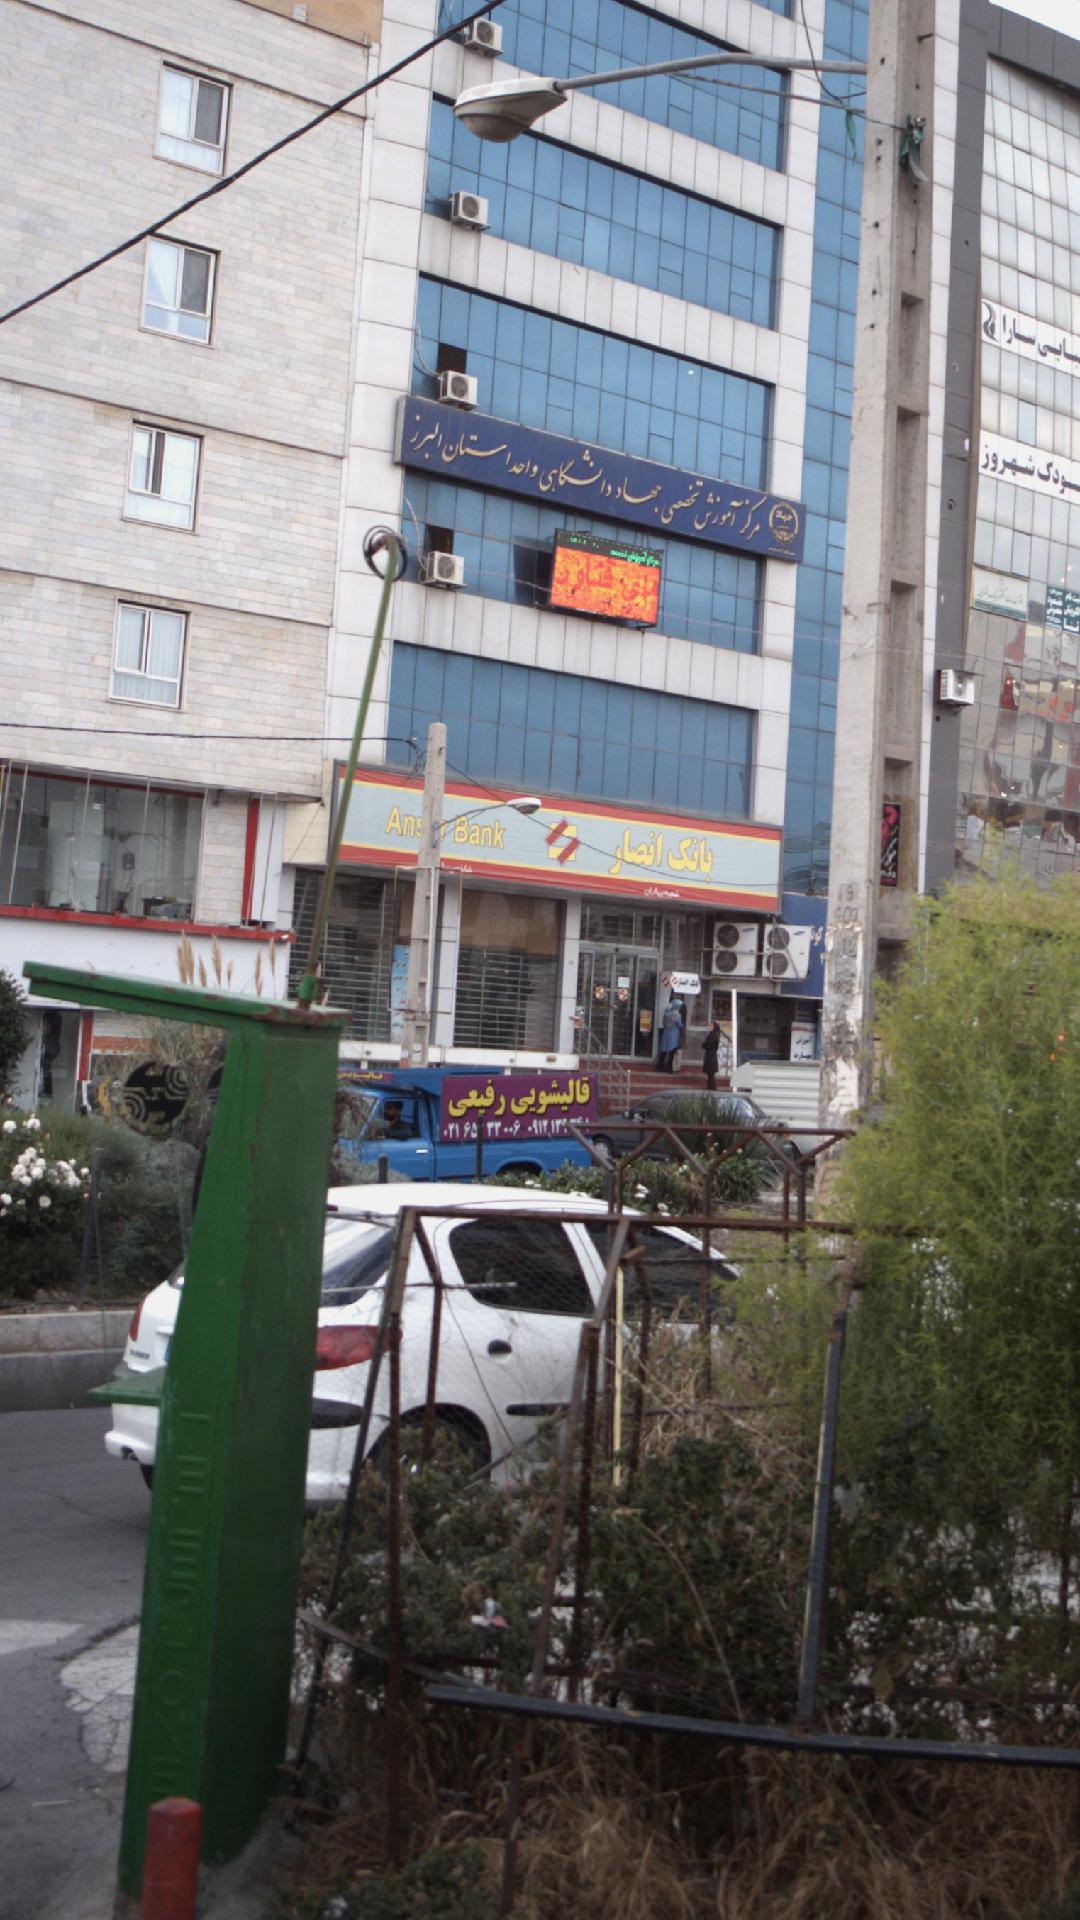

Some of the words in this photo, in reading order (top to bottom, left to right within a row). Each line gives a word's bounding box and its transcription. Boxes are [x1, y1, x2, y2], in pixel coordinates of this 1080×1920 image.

[1002, 314, 1036, 345] سارا
[410, 415, 443, 459] البرز
[441, 433, 512, 466] استان
[508, 458, 539, 478] واحد
[539, 449, 612, 498] دانشگاهی
[981, 444, 1036, 477] شهروز
[615, 477, 662, 514] جهاد
[661, 480, 704, 525] تخصصی
[694, 492, 744, 530] آموزش
[739, 495, 768, 540] مرکز
[454, 815, 506, 848] Bank
[608, 827, 663, 875] انصار
[667, 836, 713, 884] بانک
[448, 1078, 507, 1117] رفیعی
[511, 1076, 590, 1115] قالیشویی
